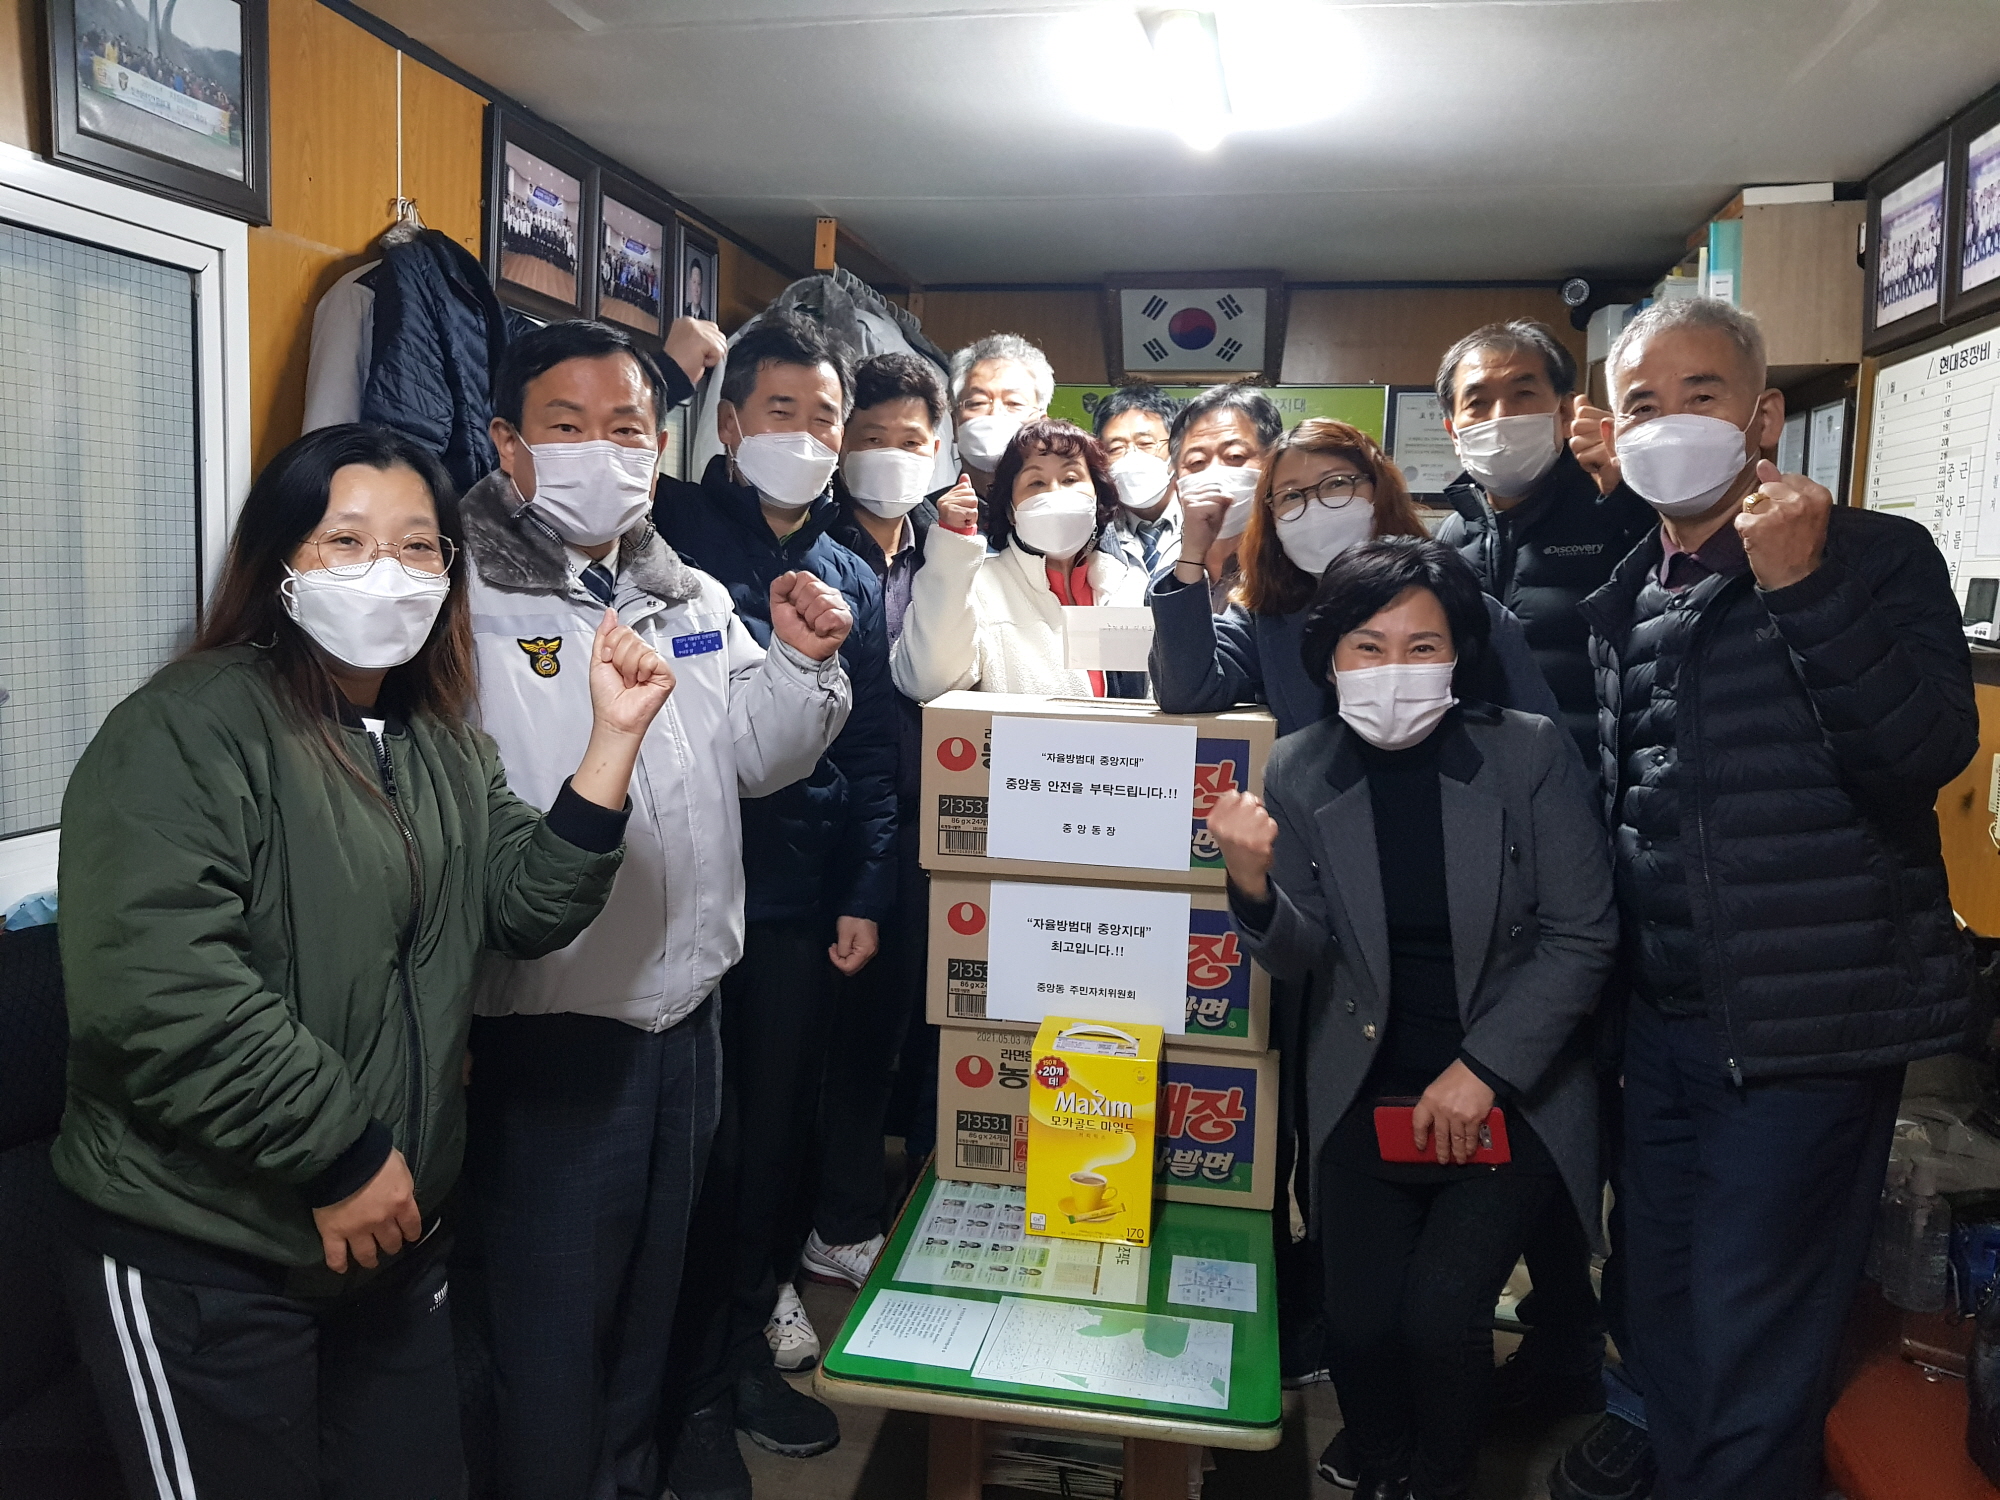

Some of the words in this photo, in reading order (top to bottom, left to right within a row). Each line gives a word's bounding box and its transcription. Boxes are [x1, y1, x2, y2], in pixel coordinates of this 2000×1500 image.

[1939, 341, 1991, 375] 현대중장비
[1543, 543, 1604, 555] Discovery
[1005, 777, 1042, 792] 중앙동
[1047, 780, 1084, 794] 안전을
[1089, 783, 1178, 799] 부탁드립니다.!!
[1050, 940, 1124, 957] 최고입니다.!!
[1036, 982, 1065, 994] 중앙동
[1069, 985, 1136, 1000] 주민자치위원회
[976, 1031, 1021, 1045] 2021.05.03
[1054, 1089, 1133, 1119] Maxim
[959, 1113, 1009, 1131] 가3531
[1050, 1115, 1097, 1130] 모카골드
[1100, 1120, 1135, 1134] 마일드
[1126, 1227, 1145, 1239] 170
